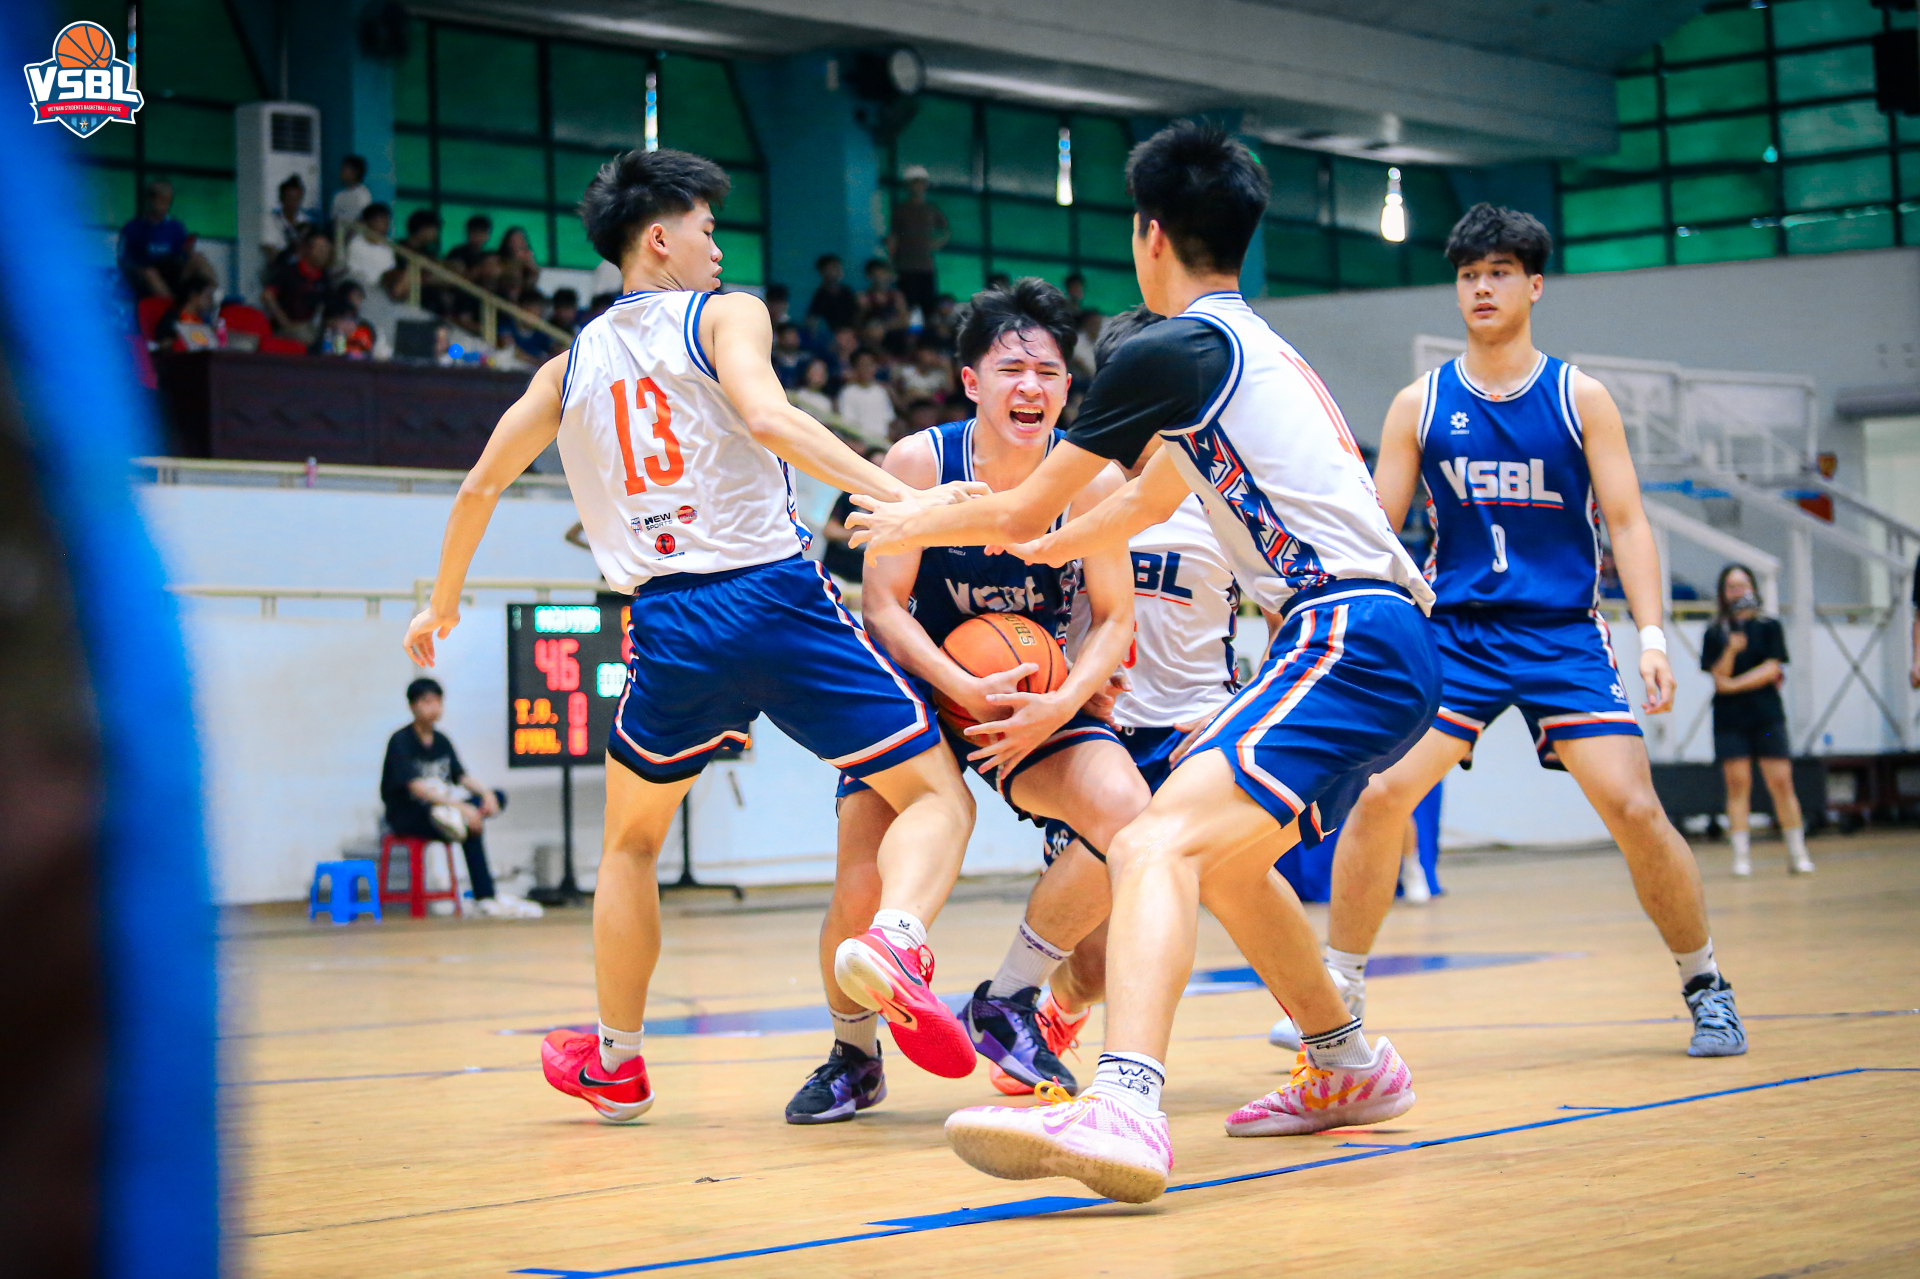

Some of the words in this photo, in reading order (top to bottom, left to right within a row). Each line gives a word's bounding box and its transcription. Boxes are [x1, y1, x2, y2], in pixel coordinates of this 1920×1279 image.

[610, 376, 684, 496] 13
[1439, 456, 1564, 505] VSBL
[644, 513, 671, 526] NEW
[646, 519, 673, 531] SPORTS
[1130, 551, 1193, 600] BL
